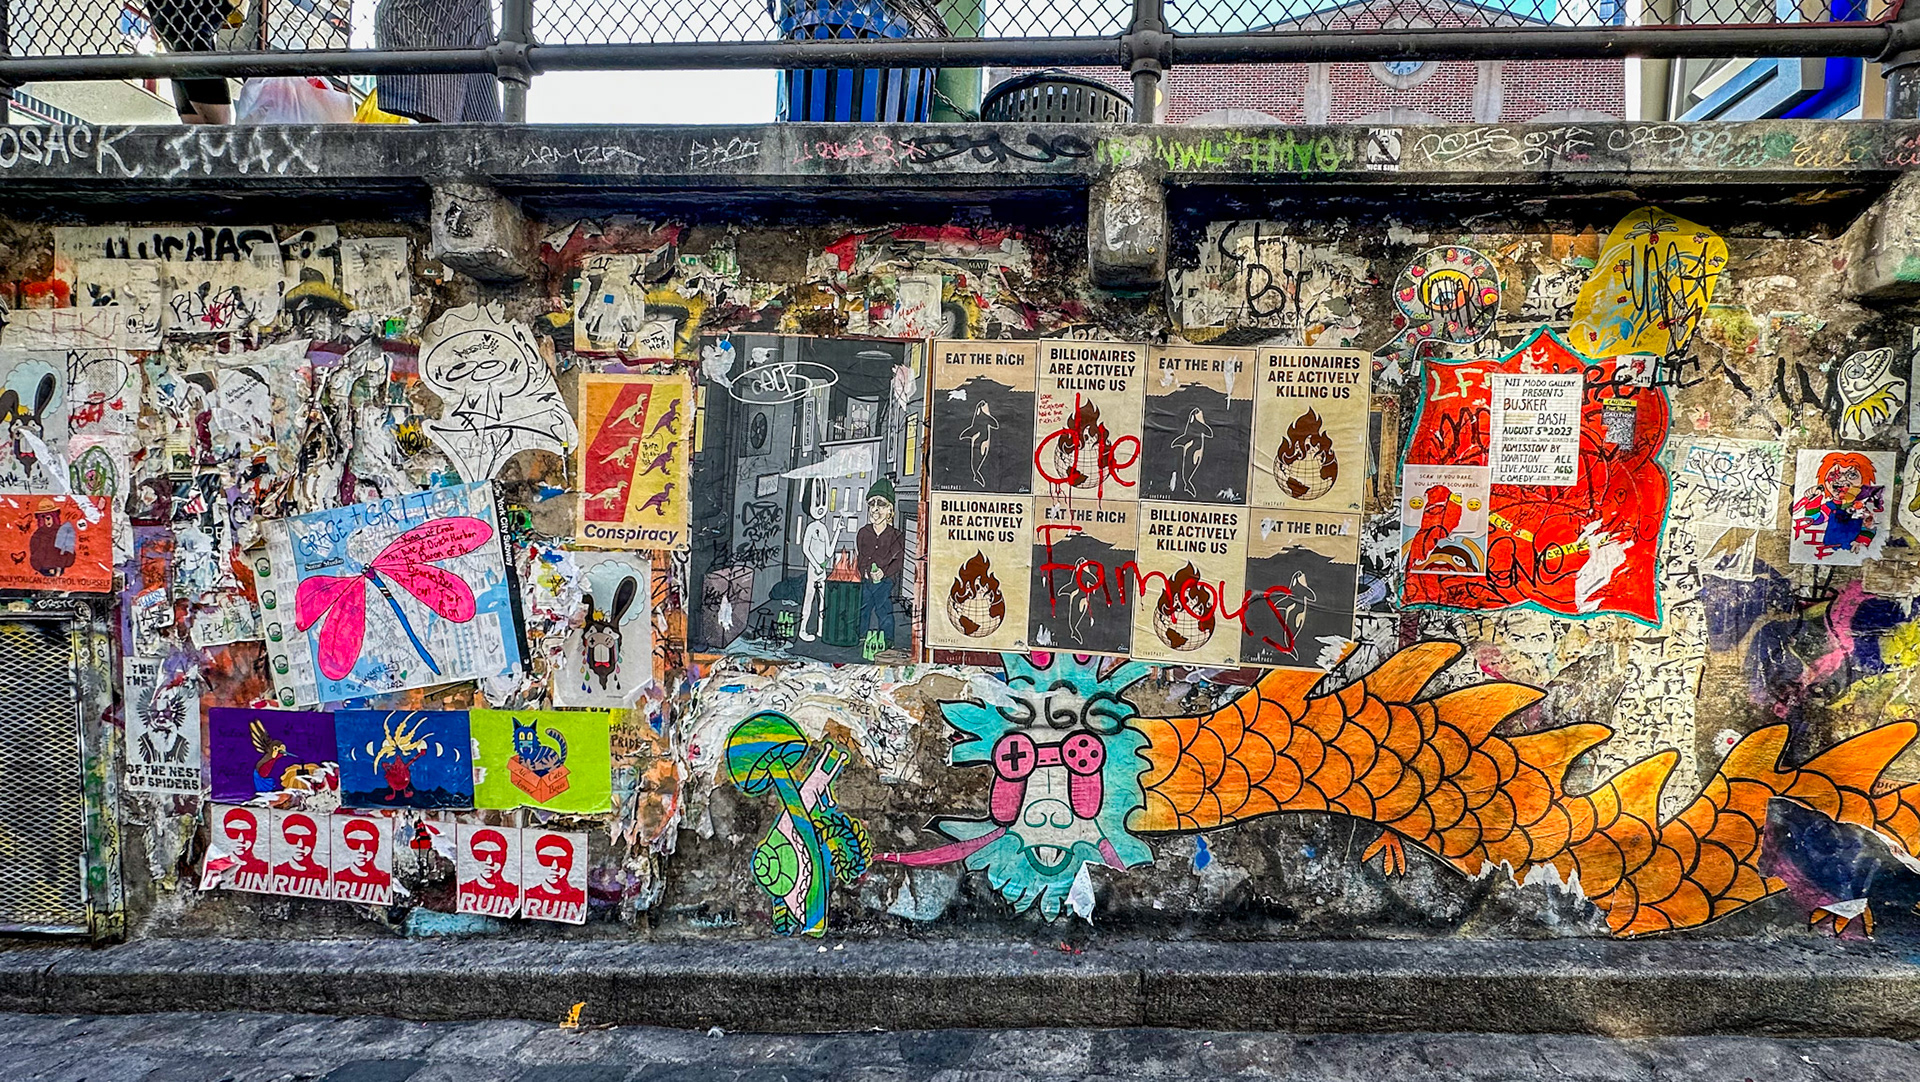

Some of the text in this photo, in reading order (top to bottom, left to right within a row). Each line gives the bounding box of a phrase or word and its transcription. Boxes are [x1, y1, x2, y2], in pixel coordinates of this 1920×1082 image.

[945, 353, 1025, 366] EAT THE RICH
[1050, 348, 1136, 363] BILLIONAIRES
[1269, 355, 1361, 369] BILLIONAIRES
[1049, 363, 1136, 377] ARE ACTIVELY
[1158, 357, 1243, 373] EAT THE RIH
[1267, 370, 1359, 384] ARE ACTIVELY
[1505, 378, 1520, 386] NII
[1523, 379, 1546, 387] MODO
[1056, 378, 1126, 391] KILLING US
[1276, 385, 1350, 399] KILLING US
[1522, 388, 1564, 398] PRESENTS
[1503, 397, 1547, 411] BUSKER
[1537, 412, 1567, 425] BASH
[1503, 426, 1534, 435] AUGUST
[1548, 426, 1573, 436] 2023
[1502, 443, 1561, 453] ADMISSION BY
[1501, 454, 1541, 463] DONATION
[1500, 464, 1518, 473] LIVE
[1519, 464, 1549, 474] MUSIC
[497, 496, 506, 516] York
[941, 500, 1023, 515] BILLIONAIRES
[940, 515, 1024, 529] ARE ACTIVELY
[1045, 507, 1126, 524] EAT THE RICH
[1150, 509, 1238, 526] BILLIONAIRES
[300, 517, 348, 557] GRACE
[365, 491, 432, 527] GRIT
[500, 517, 509, 534] City
[1261, 520, 1284, 533] AT
[1287, 521, 1311, 534] THE
[584, 524, 679, 545] Conspiracy
[948, 529, 1015, 542] KILLING US
[1148, 524, 1238, 541] ARE ACTIVELY
[503, 534, 514, 566] Subway
[1156, 538, 1228, 555] KILLING US
[77, 578, 111, 587] YOURSELF
[127, 764, 200, 778] OF THE NEST
[130, 777, 199, 790] OF SPIDERS
[273, 873, 330, 899] RUIN
[334, 880, 391, 905] RUIN
[459, 892, 520, 914] RUIN
[522, 898, 584, 922] RUIN
